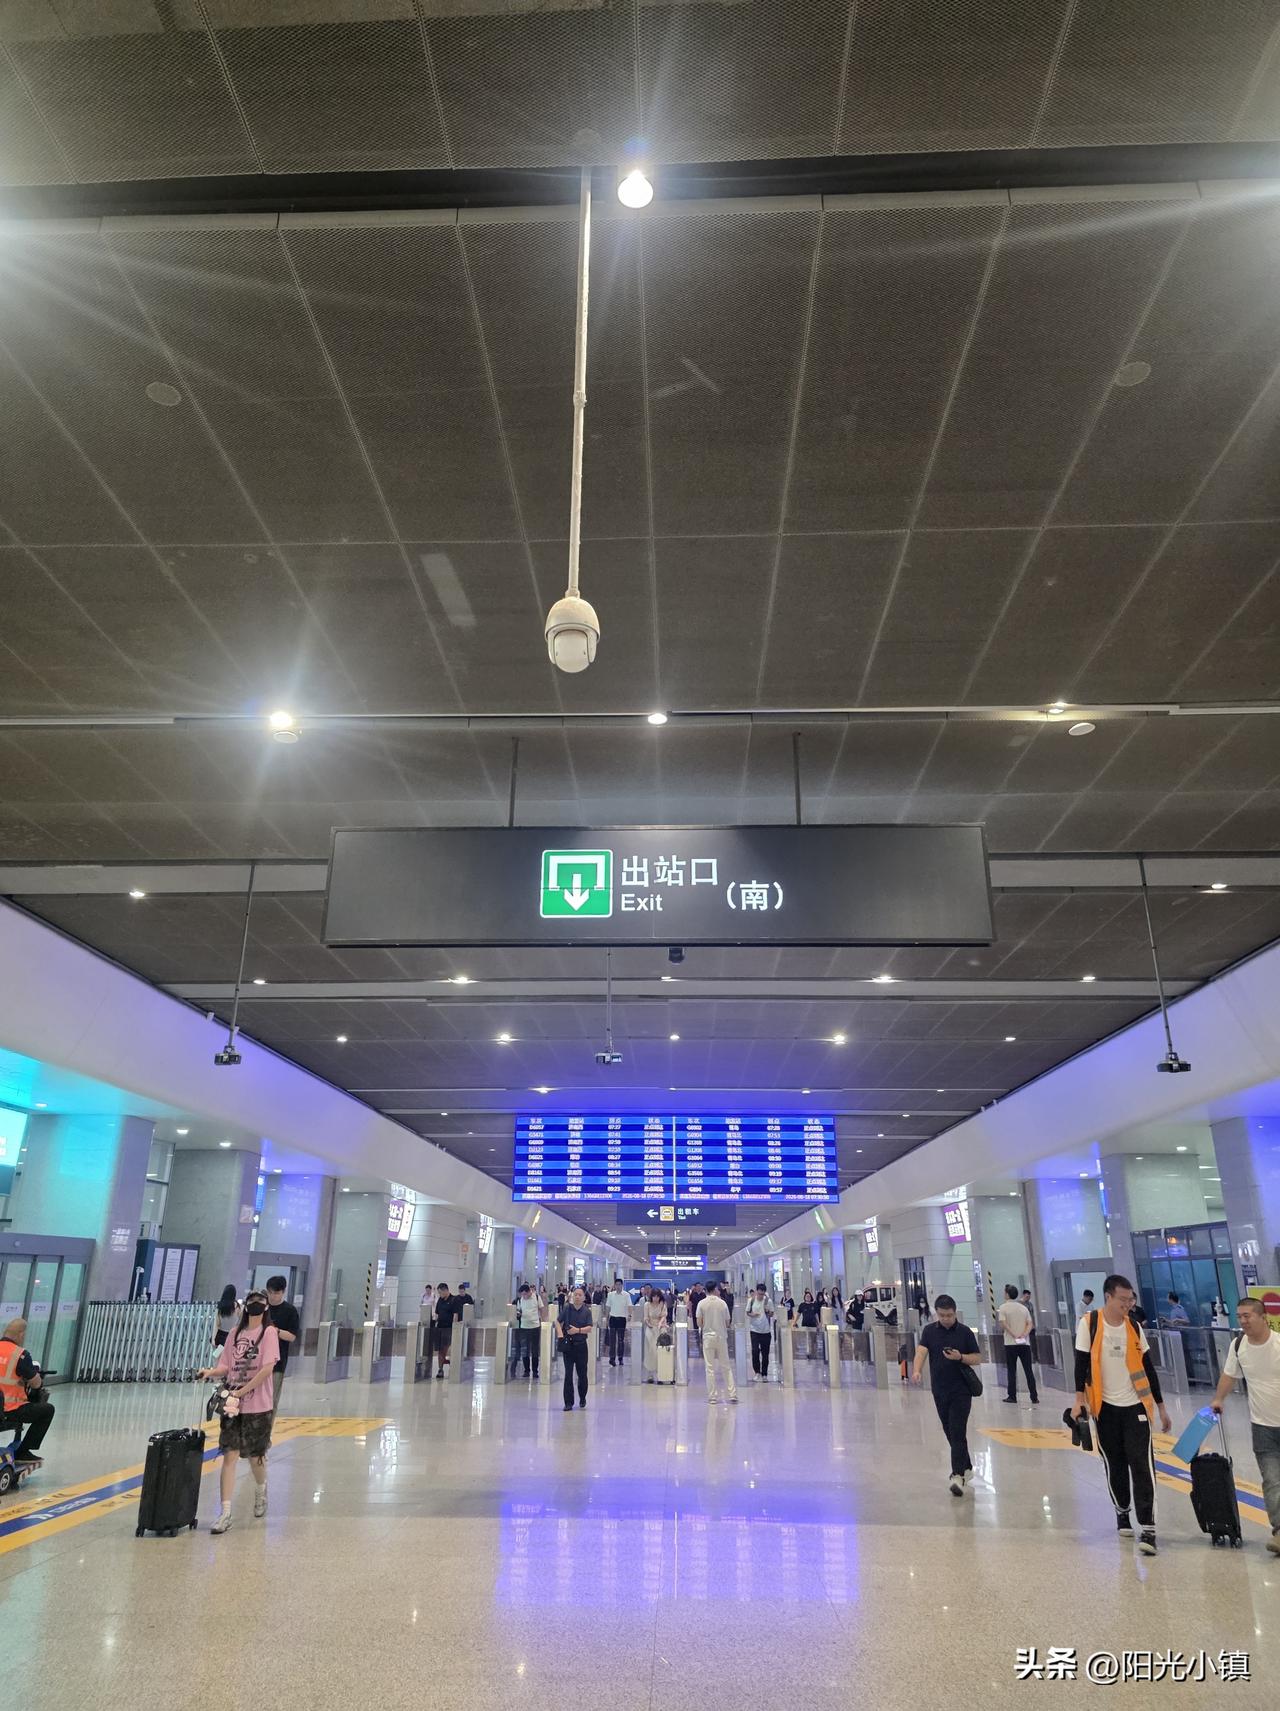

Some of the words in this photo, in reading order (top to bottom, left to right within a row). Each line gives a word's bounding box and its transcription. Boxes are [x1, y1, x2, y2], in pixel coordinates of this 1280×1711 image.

[621, 855, 718, 887] 出站口
[621, 893, 663, 912] Exit
[726, 880, 784, 911] (南)
